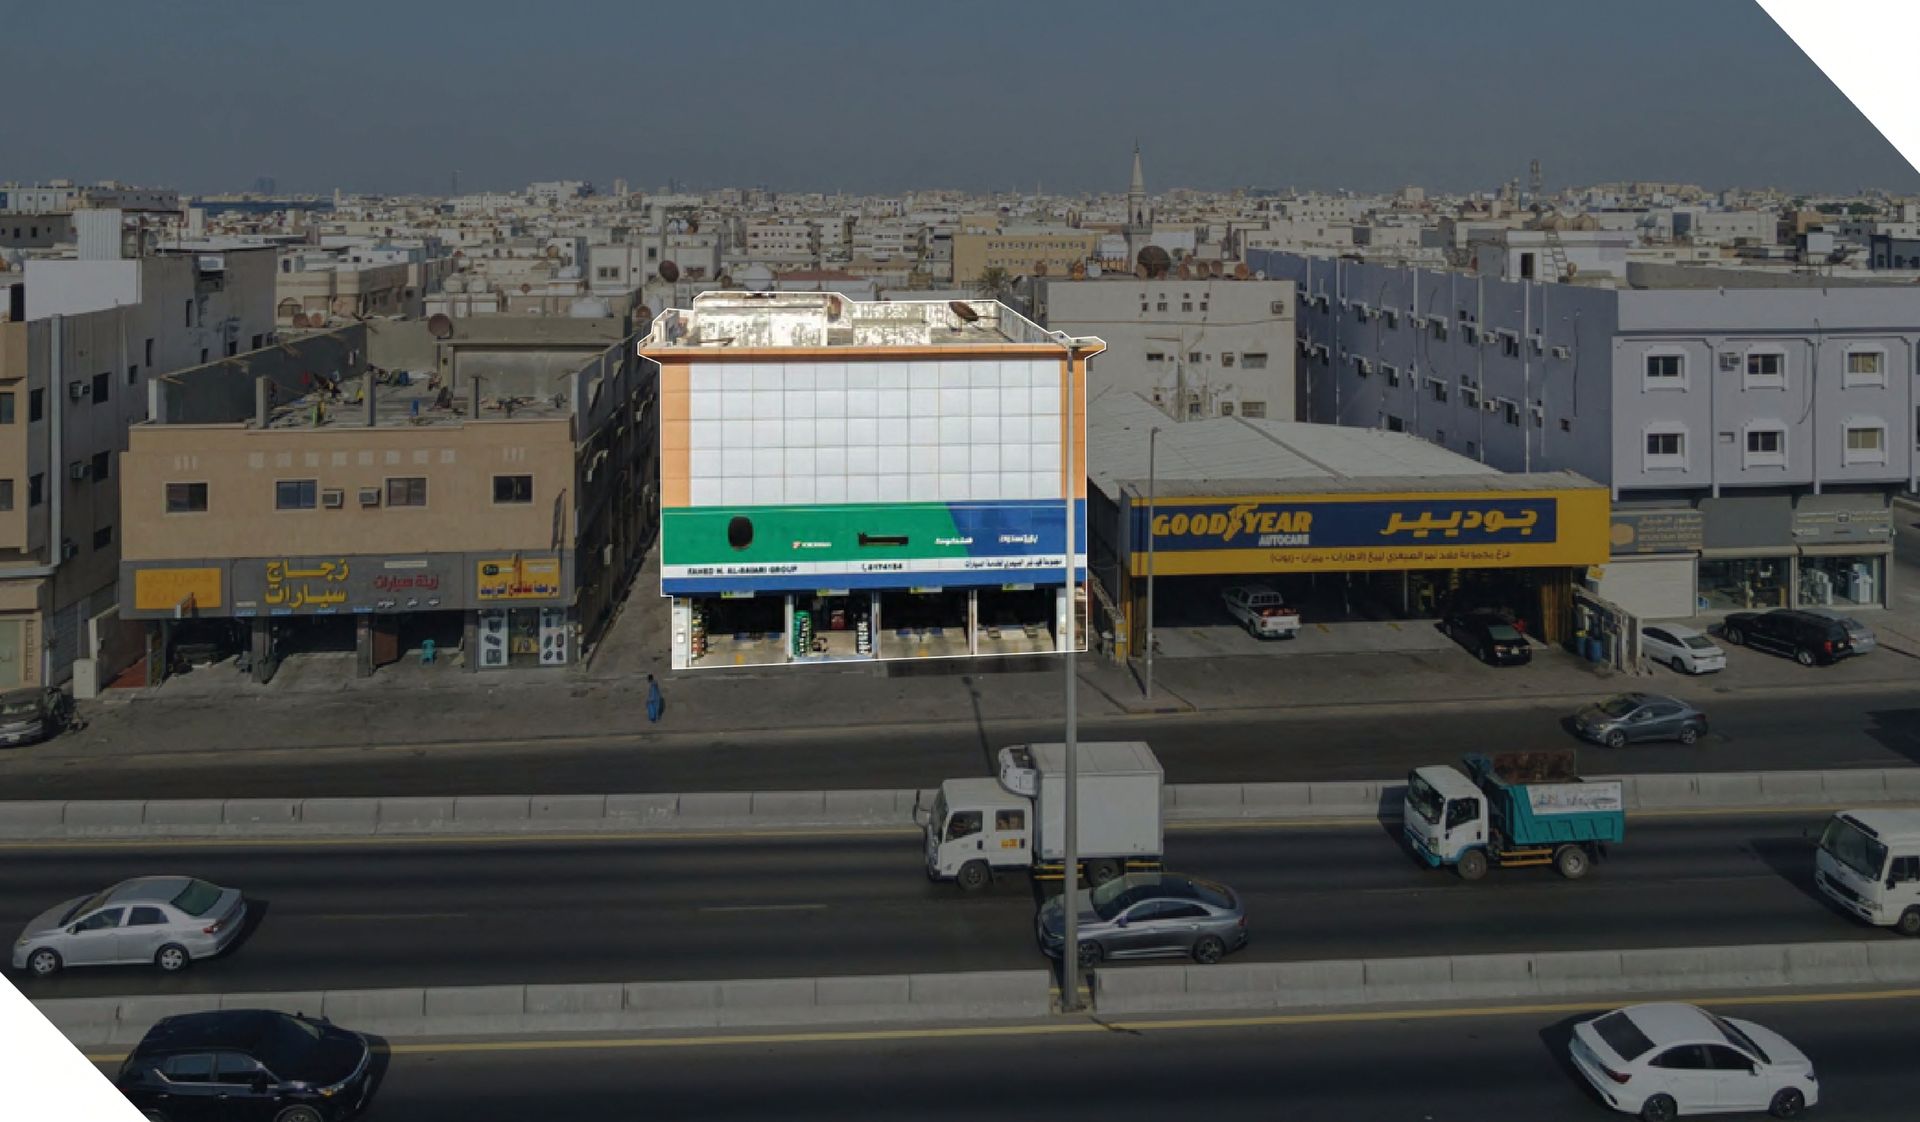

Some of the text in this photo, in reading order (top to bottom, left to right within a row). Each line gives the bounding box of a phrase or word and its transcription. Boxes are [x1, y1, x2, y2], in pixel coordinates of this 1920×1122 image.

[1152, 505, 1312, 541] GOODYEAR
[1380, 509, 1538, 537] جوديير
[1259, 534, 1310, 546] AUTOCARE
[265, 558, 350, 584] زجاج
[264, 583, 347, 609] سيارات
